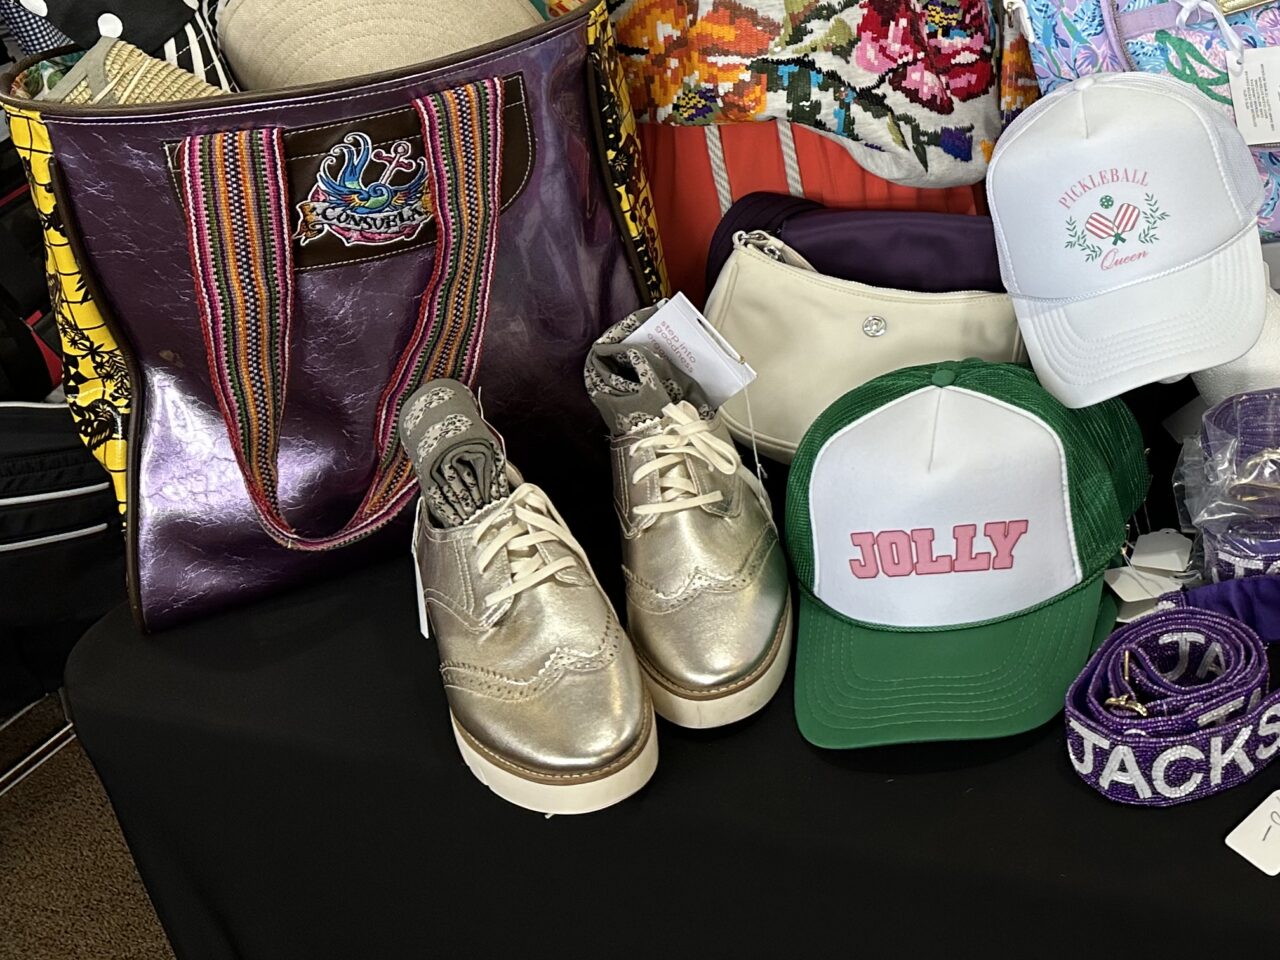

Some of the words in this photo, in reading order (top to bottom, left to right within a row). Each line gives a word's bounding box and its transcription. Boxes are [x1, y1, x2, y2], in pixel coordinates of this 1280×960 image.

[1058, 167, 1148, 210] PICKLEBALL
[1100, 247, 1148, 271] Queen
[654, 325, 694, 374] goodness
[680, 342, 697, 364] into
[848, 519, 1029, 579] JOLLY
